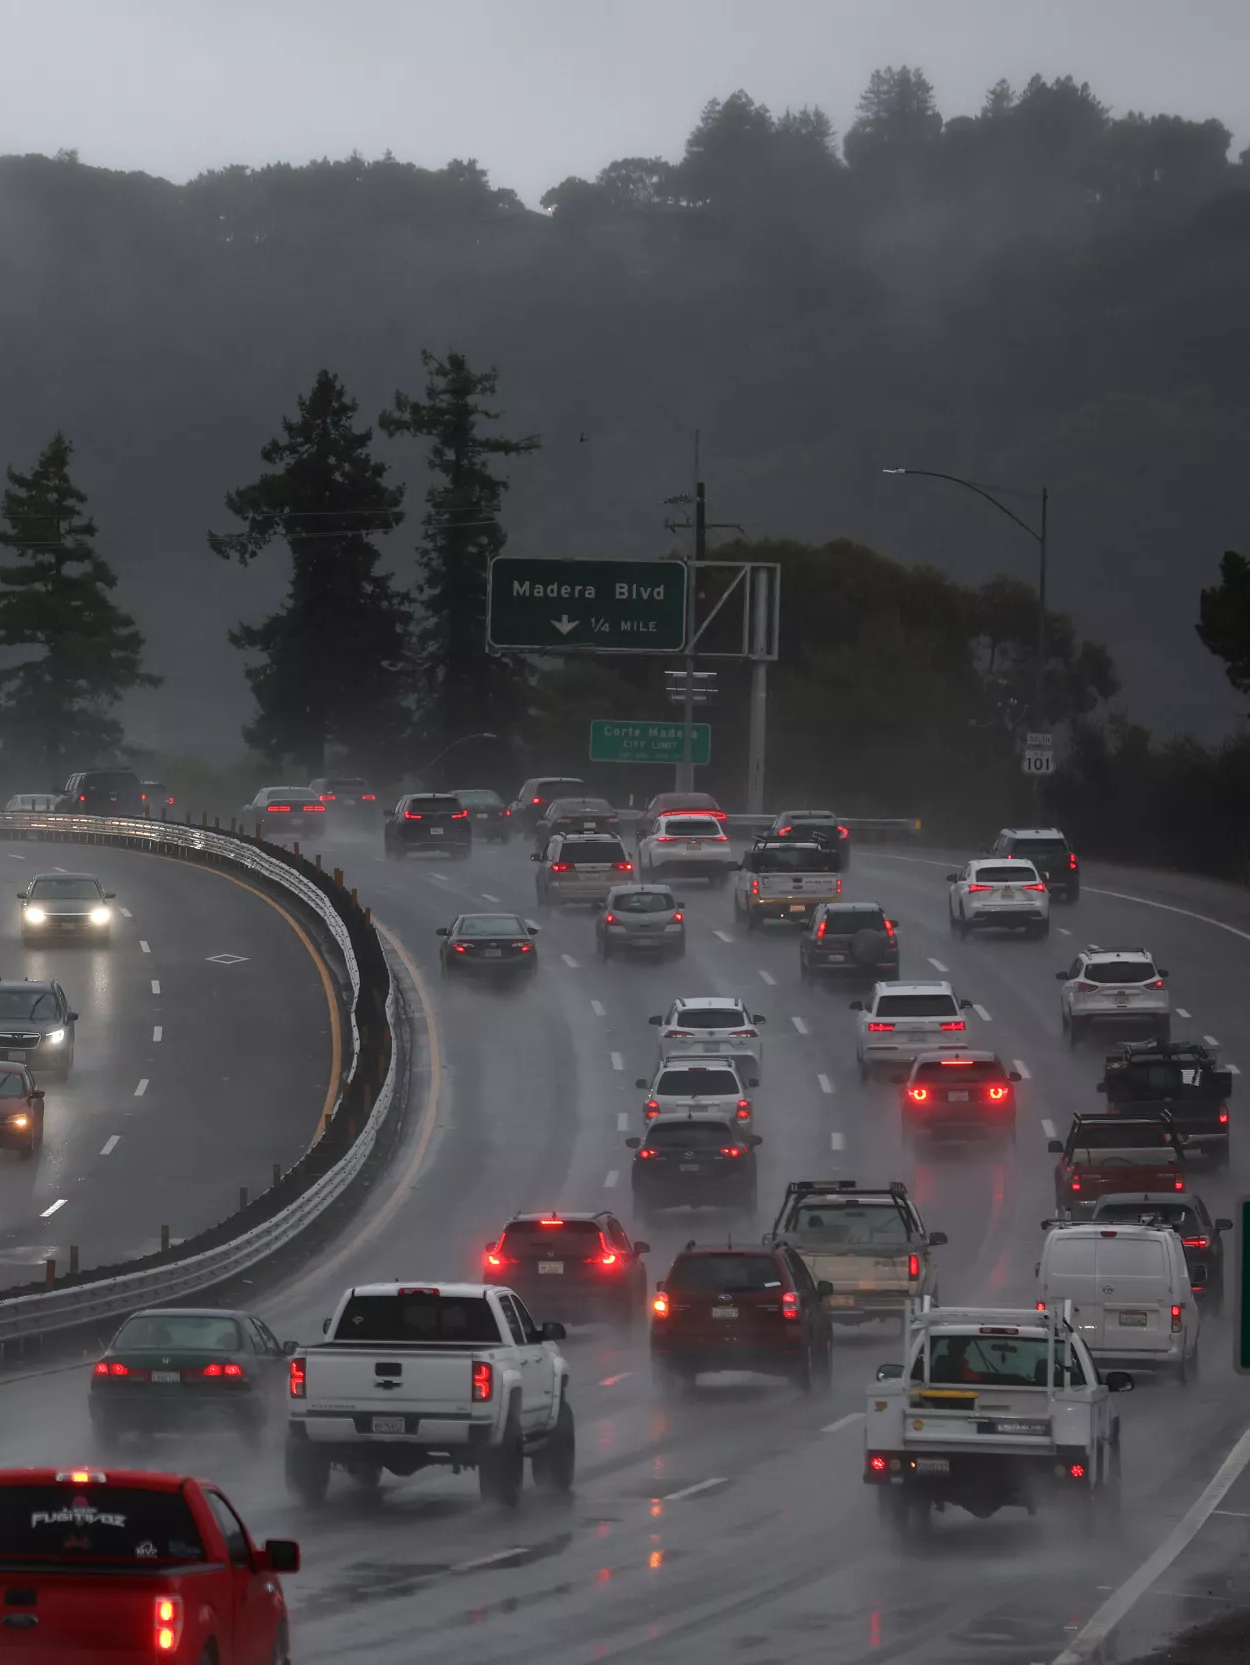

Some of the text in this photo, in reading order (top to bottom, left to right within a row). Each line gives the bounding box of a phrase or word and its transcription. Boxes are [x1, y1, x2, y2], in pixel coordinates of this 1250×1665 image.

[513, 580, 665, 601] Madera Blvd
[620, 621, 658, 632] MILE
[603, 725, 699, 740] Corte Madea
[622, 740, 678, 750] CITY LIMIT
[1027, 757, 1049, 771] 101
